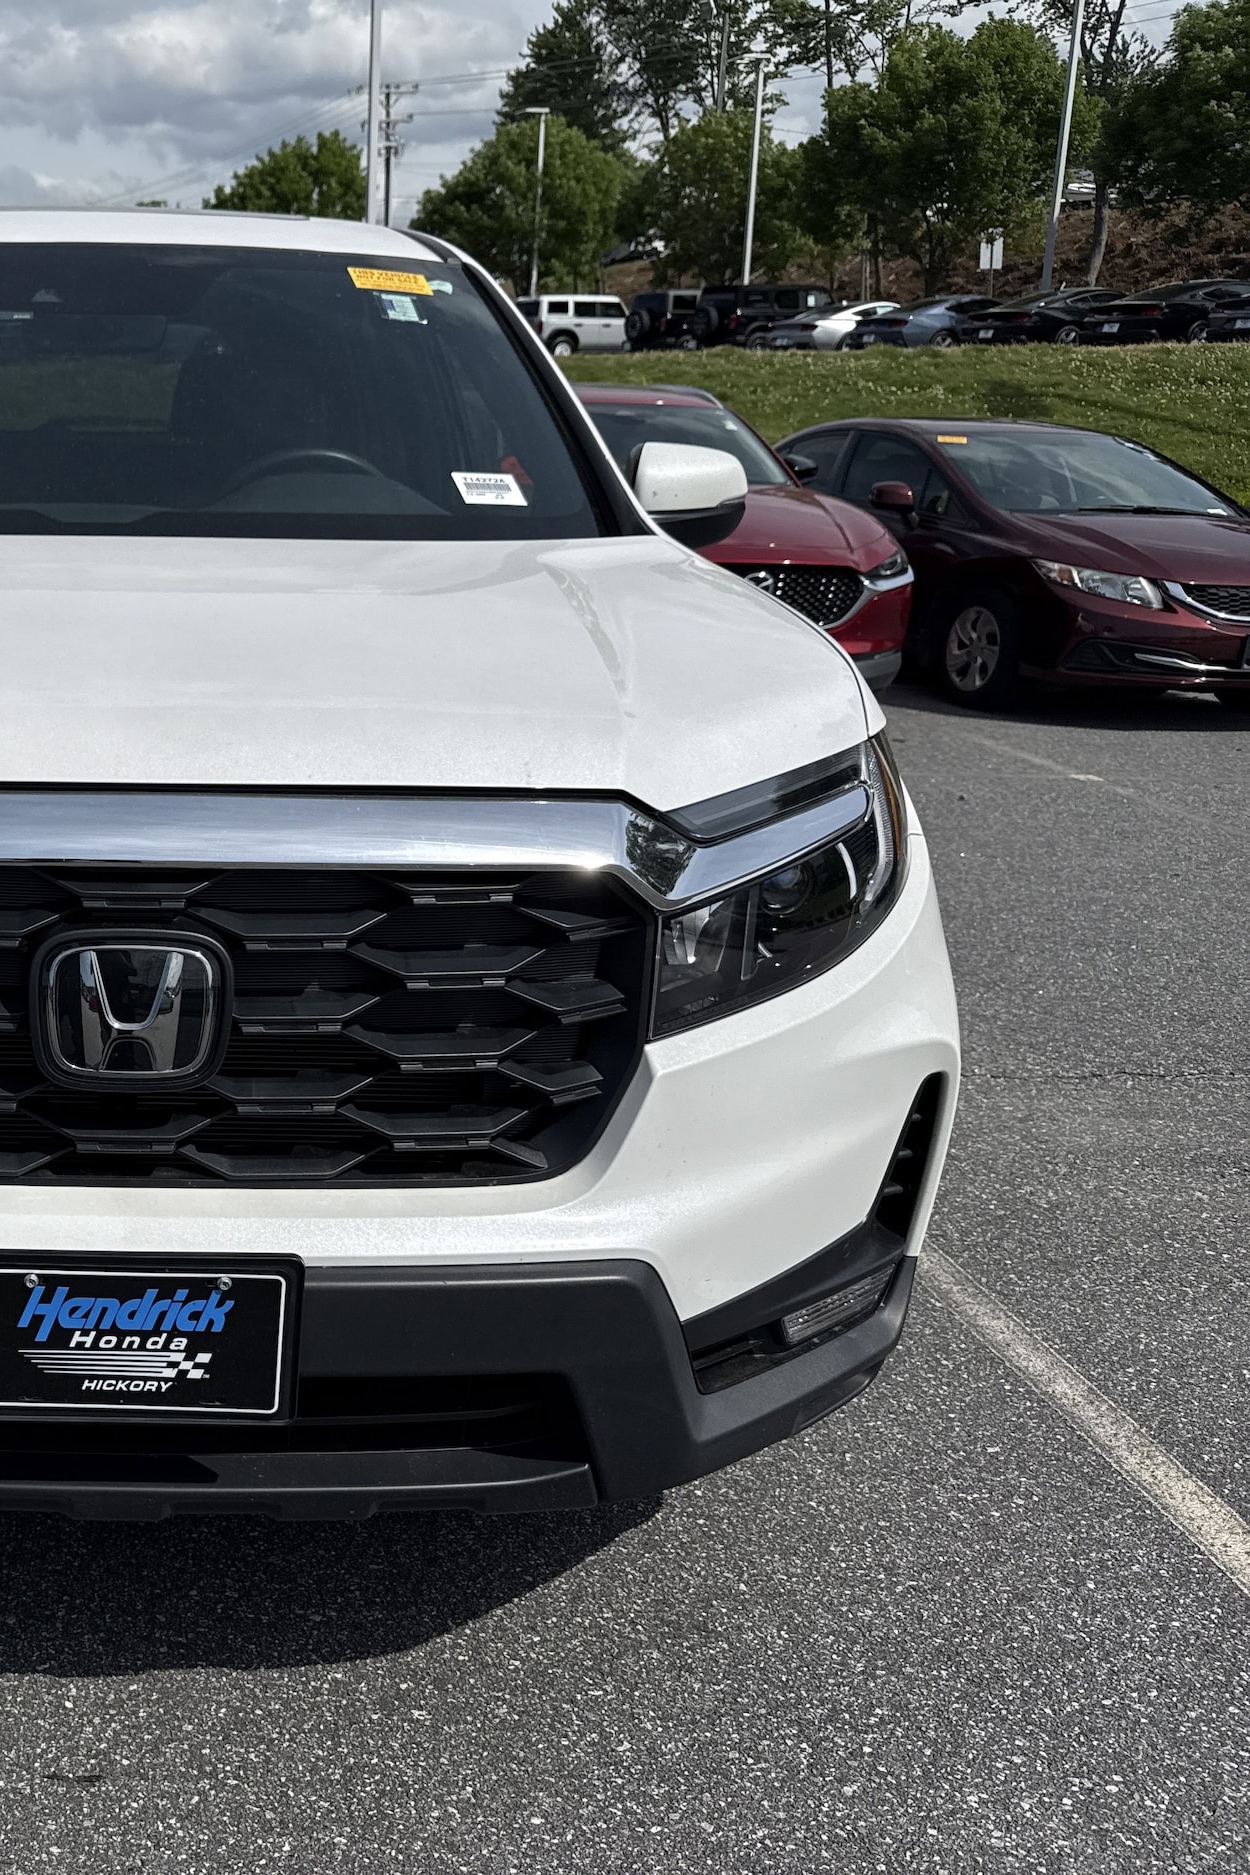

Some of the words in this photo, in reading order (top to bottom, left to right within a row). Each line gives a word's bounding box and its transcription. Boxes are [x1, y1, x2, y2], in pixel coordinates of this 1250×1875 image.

[376, 271, 419, 280] VEHICLE
[17, 1286, 235, 1342] Hendrick
[69, 1330, 189, 1351] Honda
[81, 1379, 174, 1393] HICKORY
